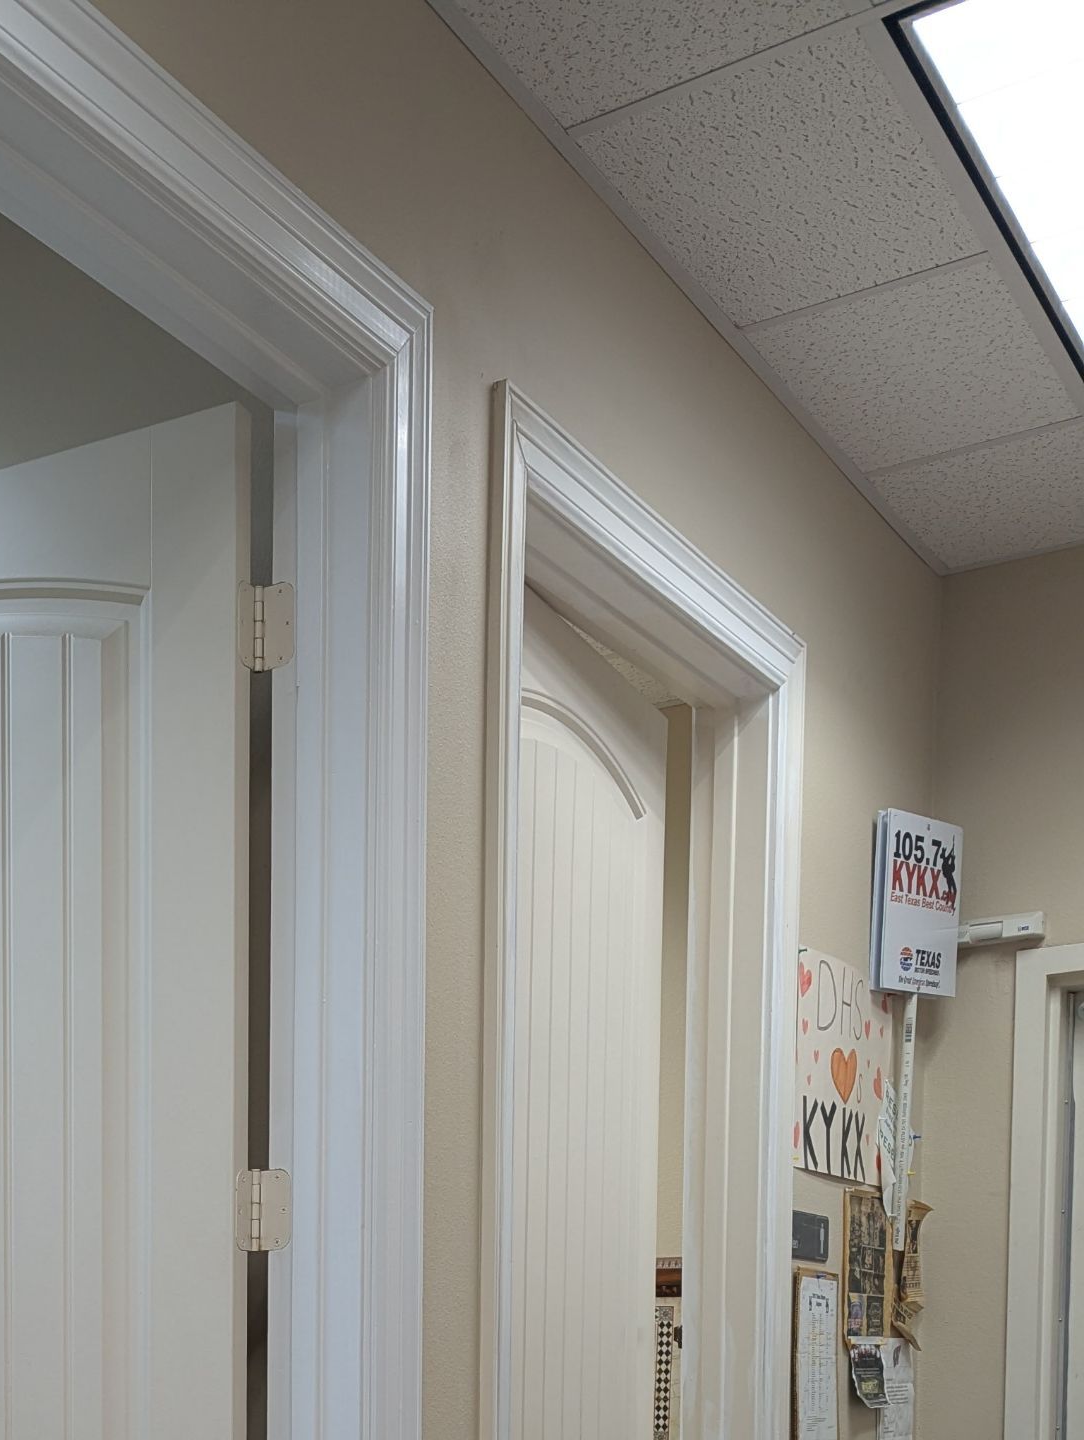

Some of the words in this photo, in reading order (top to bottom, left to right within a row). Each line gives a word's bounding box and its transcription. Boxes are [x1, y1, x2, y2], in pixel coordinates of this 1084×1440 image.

[893, 829, 942, 867] 105.7
[891, 859, 942, 901] KYKX
[890, 890, 904, 905] East
[905, 893, 921, 908] Texas
[923, 897, 935, 911] Best
[915, 948, 942, 970] TEXAS
[817, 958, 865, 1041] DHS
[803, 1094, 867, 1187] KYKX
